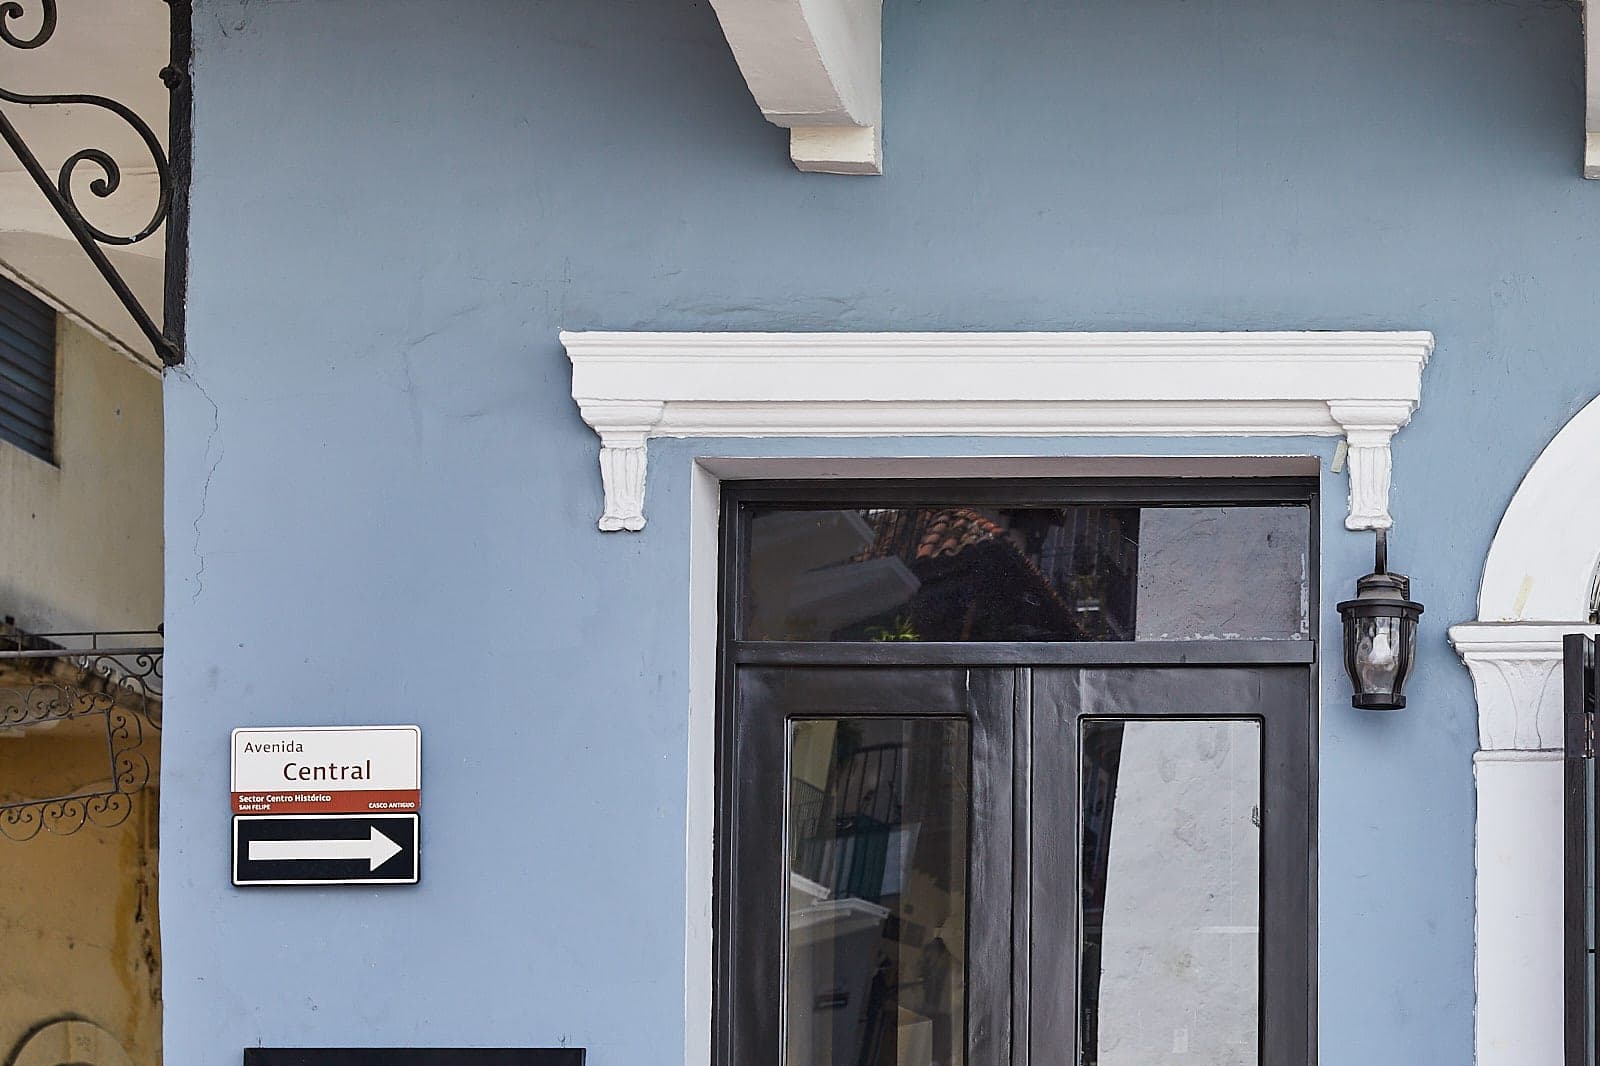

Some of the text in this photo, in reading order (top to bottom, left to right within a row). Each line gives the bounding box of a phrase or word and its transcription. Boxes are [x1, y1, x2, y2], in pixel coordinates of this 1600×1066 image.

[244, 740, 304, 753] Avenida
[283, 760, 371, 781] Central
[239, 793, 332, 803] Sector Centro Histórico
